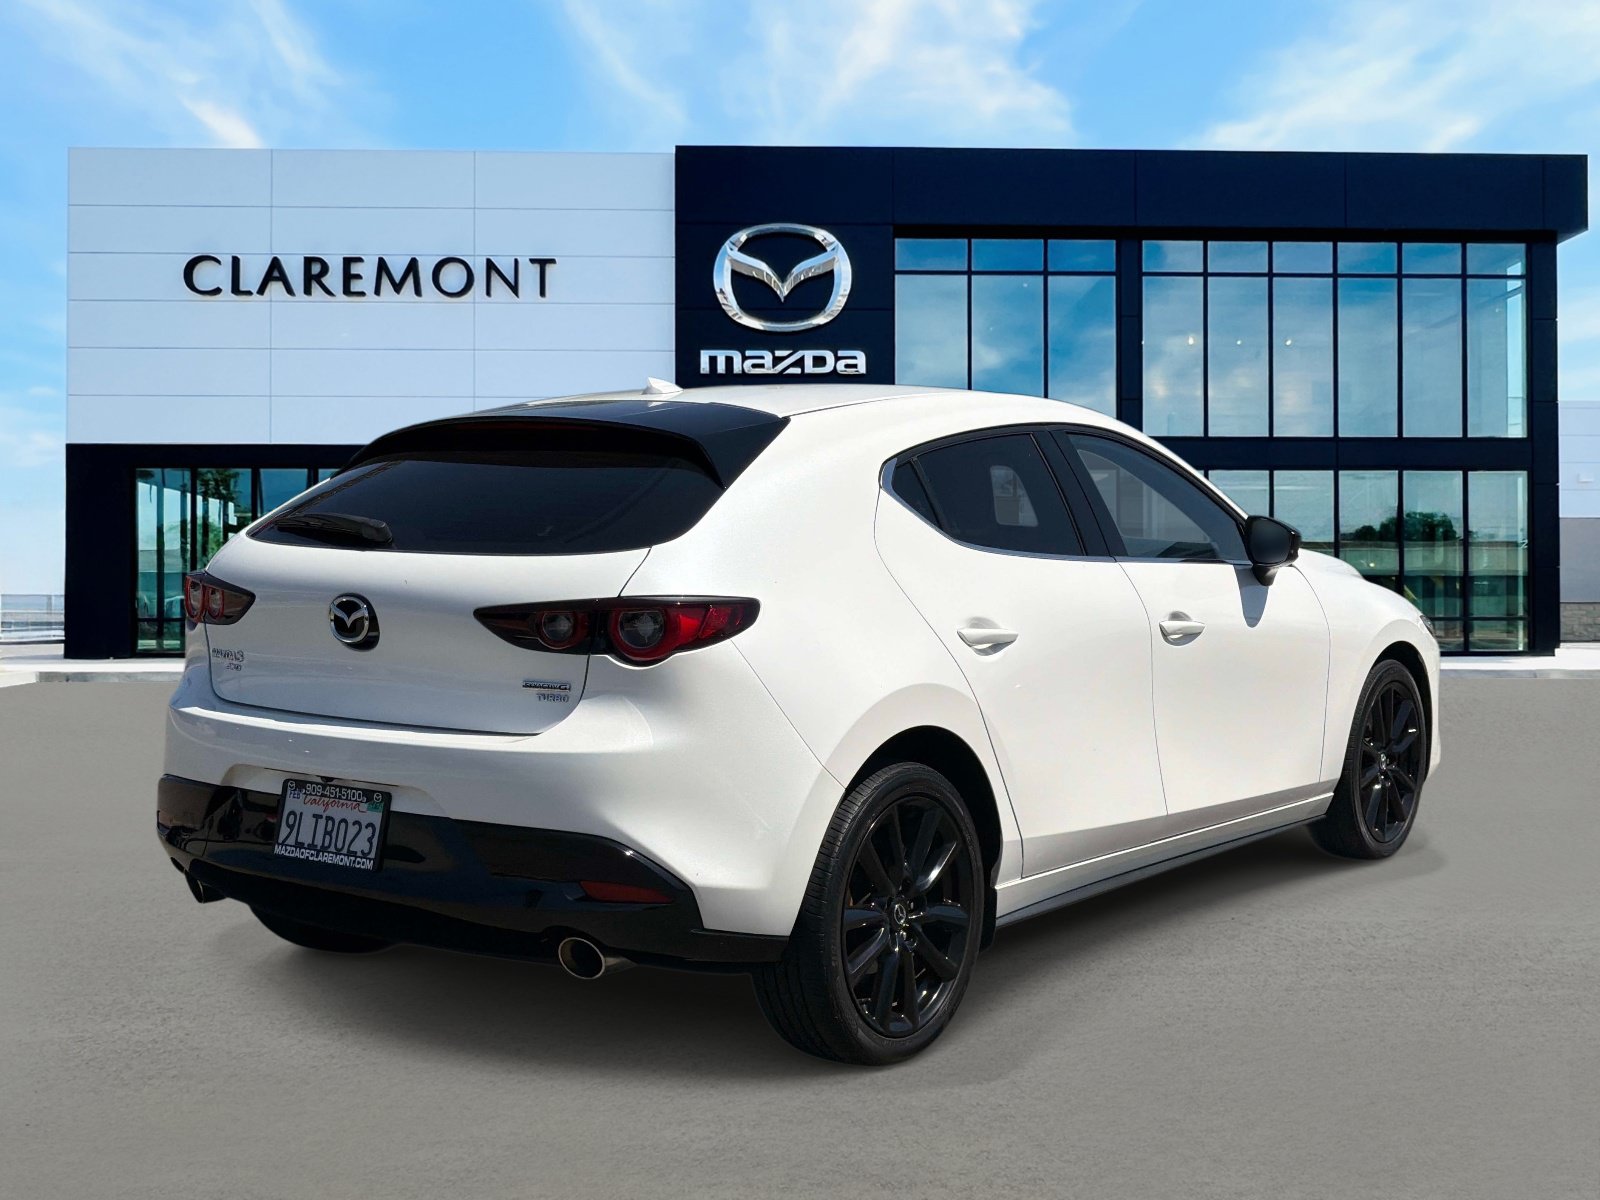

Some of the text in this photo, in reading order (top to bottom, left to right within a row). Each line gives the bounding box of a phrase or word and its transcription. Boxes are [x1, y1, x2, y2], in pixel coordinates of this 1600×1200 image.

[183, 255, 557, 298] CLAREMONT
[536, 693, 570, 703] TURBO
[305, 784, 363, 801] 909-451-5100
[274, 844, 374, 870] MAZDAOFCLAREMONT.COM
